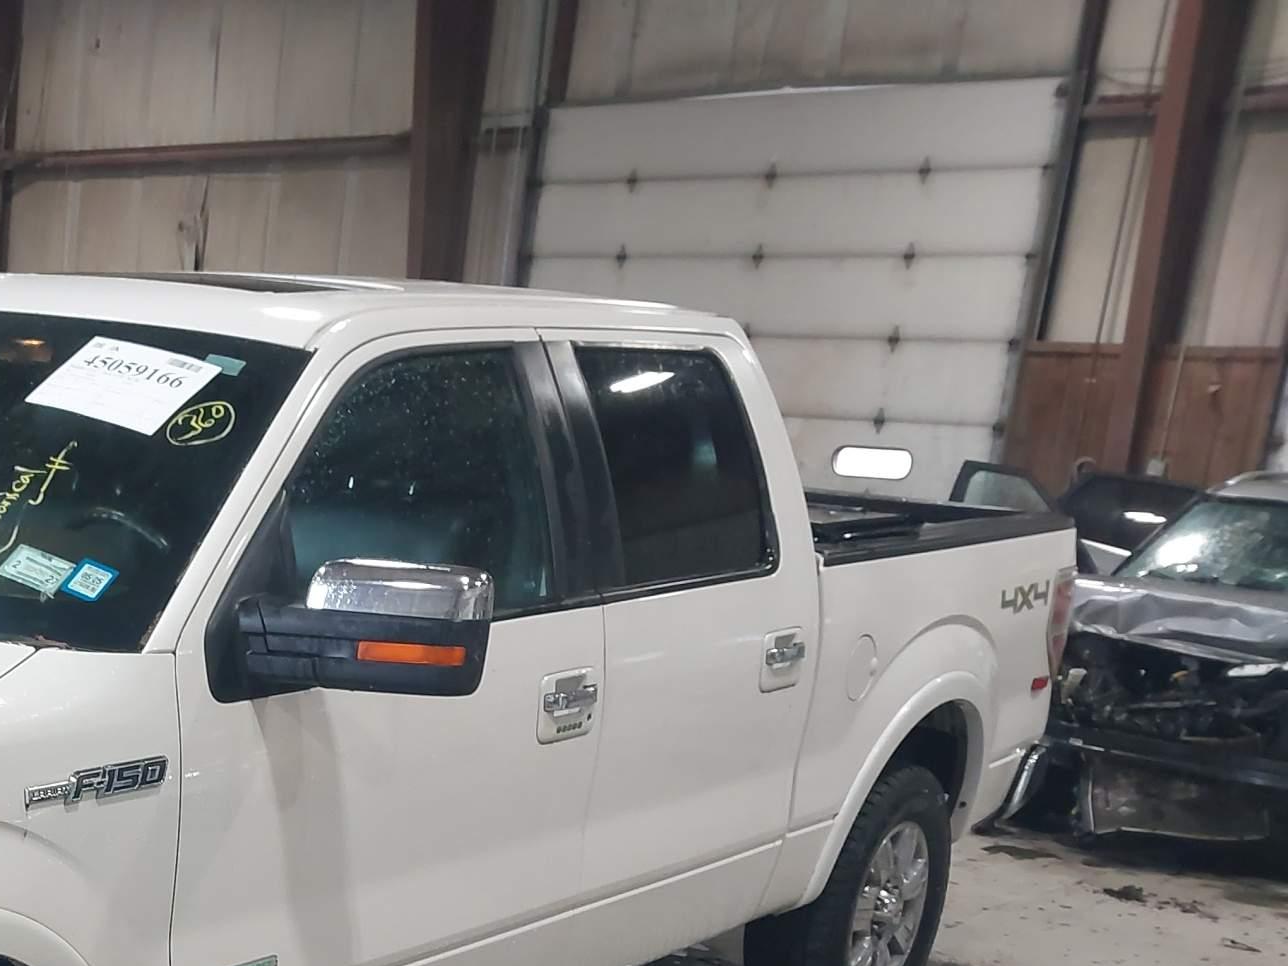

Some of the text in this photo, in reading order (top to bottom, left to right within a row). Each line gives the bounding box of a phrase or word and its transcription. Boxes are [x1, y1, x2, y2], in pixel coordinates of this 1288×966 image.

[83, 355, 187, 390] 45059166
[177, 404, 225, 441] 360
[70, 755, 169, 801] F-150
